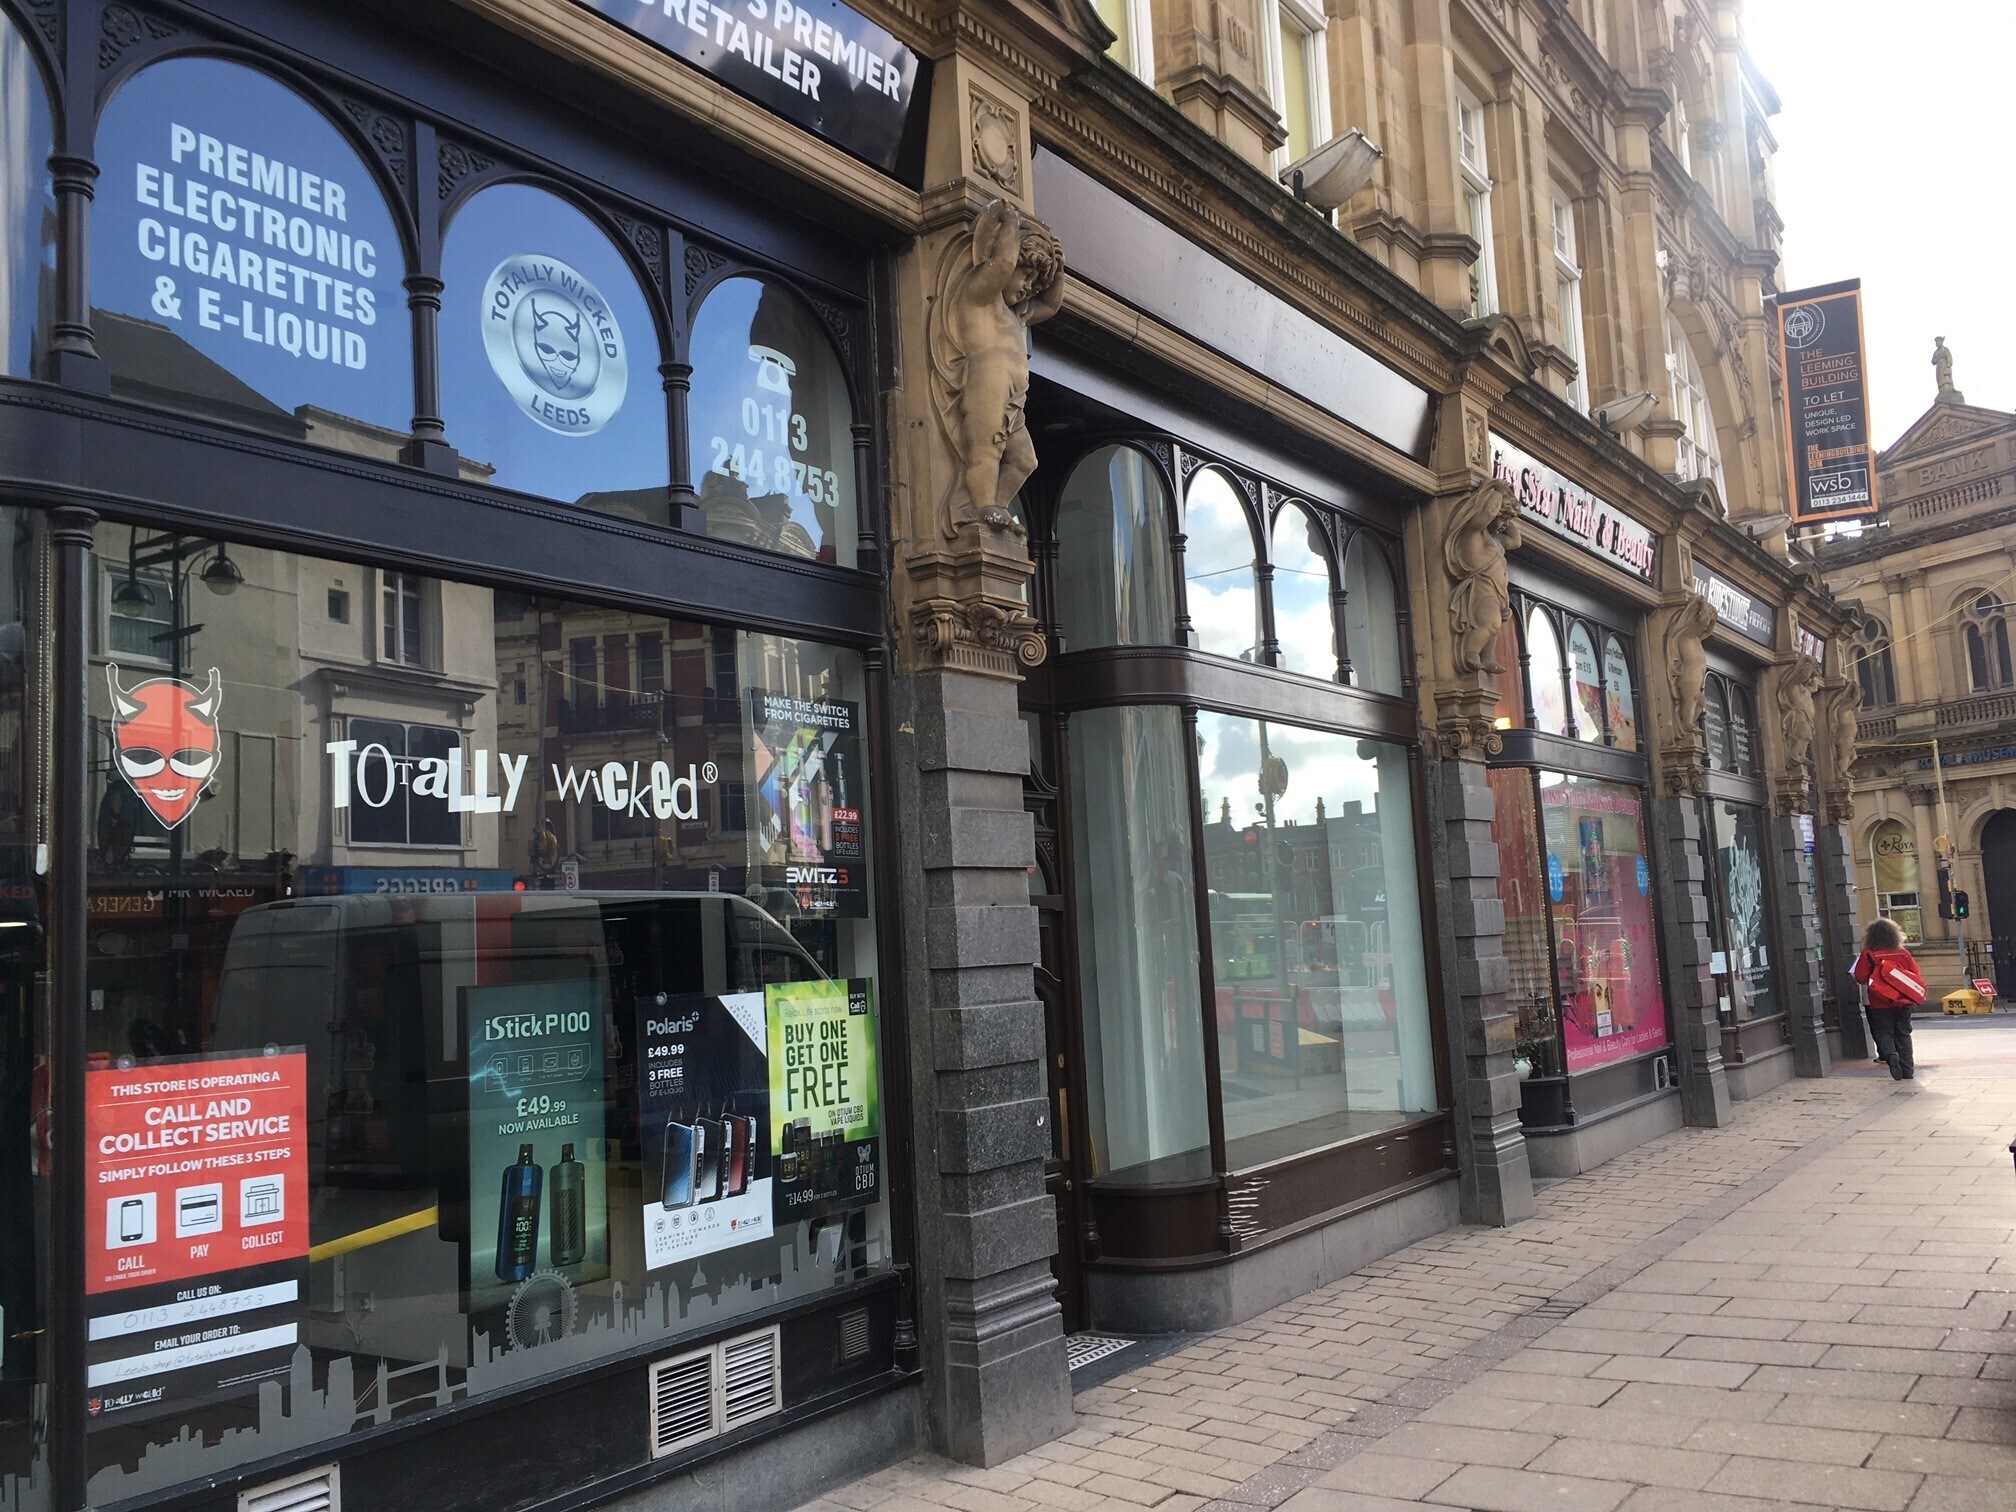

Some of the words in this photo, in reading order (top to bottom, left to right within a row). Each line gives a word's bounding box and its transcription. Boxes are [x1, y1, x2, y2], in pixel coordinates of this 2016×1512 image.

[662, 0, 822, 101] RETAILER
[774, 0, 901, 102] PREMIER
[171, 122, 347, 222] PREMIER
[135, 162, 378, 279] ELECTRONIC
[137, 218, 377, 326] CIGARETTES
[490, 260, 556, 322] TOTALLY
[560, 272, 618, 360] WICKED
[151, 275, 182, 322] &
[199, 289, 367, 371] E-LIQUID
[1800, 348, 1823, 360] THE
[1800, 356, 1853, 374] LEEMING
[1801, 369, 1859, 388] BUILDING
[1803, 395, 1820, 405] TO
[1823, 390, 1845, 403] LET
[530, 392, 593, 427] LEEDS
[742, 397, 808, 451] 0113
[1805, 418, 1835, 428] DESIGN
[1836, 414, 1851, 423] LED
[1805, 427, 1829, 436] WORK
[1831, 422, 1856, 433] SPACE
[711, 436, 766, 487] 244
[774, 455, 840, 508] 8753
[1812, 472, 1852, 492] wsb
[1813, 498, 1830, 507] 0113
[1832, 496, 1846, 504] 234
[1848, 493, 1866, 501] 1444
[1556, 486, 1597, 540] Nails
[1596, 512, 1612, 549] &
[764, 696, 792, 710] MAKE
[793, 700, 812, 712] THE
[814, 703, 849, 718] SWITCH
[764, 708, 793, 721] FROM
[794, 712, 850, 729] CIGARETTES
[834, 809, 858, 821] £22.99
[835, 826, 859, 834] INCLUDES
[841, 834, 859, 842] FREE
[835, 841, 859, 850] BOTTLES
[1948, 1000, 1966, 1009] SRL
[485, 1013, 543, 1041] iStick
[545, 1011, 590, 1035] P100
[647, 1018, 694, 1036] Polaris
[785, 1021, 815, 1045] BUY
[820, 1019, 848, 1041] ONE
[647, 1043, 685, 1058] £49.99
[786, 1043, 815, 1068] GET
[819, 1040, 849, 1062] ONE
[648, 1058, 683, 1069] INCLUDES
[649, 1070, 656, 1081] 3
[657, 1066, 684, 1080] FREE
[111, 1084, 142, 1097] THIS
[144, 1080, 186, 1094] STORE
[188, 1078, 200, 1090] IS
[200, 1072, 271, 1089] OPERATING
[271, 1070, 280, 1082] A
[650, 1078, 684, 1090] BOTTLES
[650, 1089, 658, 1097] OF
[659, 1086, 684, 1096] E-LIQUID
[786, 1061, 851, 1112] FREE
[144, 1105, 203, 1126] CALL
[205, 1098, 251, 1119] AND
[516, 1094, 566, 1118] £49.99
[828, 1109, 836, 1118] ON
[853, 1104, 864, 1114] CBD
[498, 1122, 526, 1135] NOW
[526, 1113, 579, 1132] AVAILABLE
[830, 1116, 844, 1126] VAPE
[844, 1113, 864, 1124] LIQUIDS
[98, 1125, 203, 1155] COLLECT
[205, 1115, 290, 1143] SERVICE
[99, 1166, 148, 1184] SIMPLY
[148, 1158, 204, 1177] FOLLOW
[204, 1154, 244, 1169] THESE
[246, 1152, 253, 1164] 3
[254, 1148, 290, 1163] STEPS
[855, 1172, 875, 1191] CBD
[789, 1189, 814, 1206] £14.99
[242, 1231, 284, 1250] COLLECT
[190, 1243, 209, 1259] PAY
[118, 1255, 145, 1272] CALL
[112, 1273, 127, 1281] EMAIL
[127, 1271, 141, 1279] YOUR
[140, 1268, 157, 1277] ORDER
[176, 1290, 196, 1302] CALL
[197, 1287, 207, 1298] US
[208, 1285, 222, 1296] ON:
[123, 1308, 169, 1329] 0113
[183, 1293, 266, 1318] 2448753
[155, 1336, 179, 1350] EMAIL
[180, 1331, 201, 1344] YOUR
[202, 1328, 229, 1341] ORDER
[229, 1325, 241, 1336] TO:
